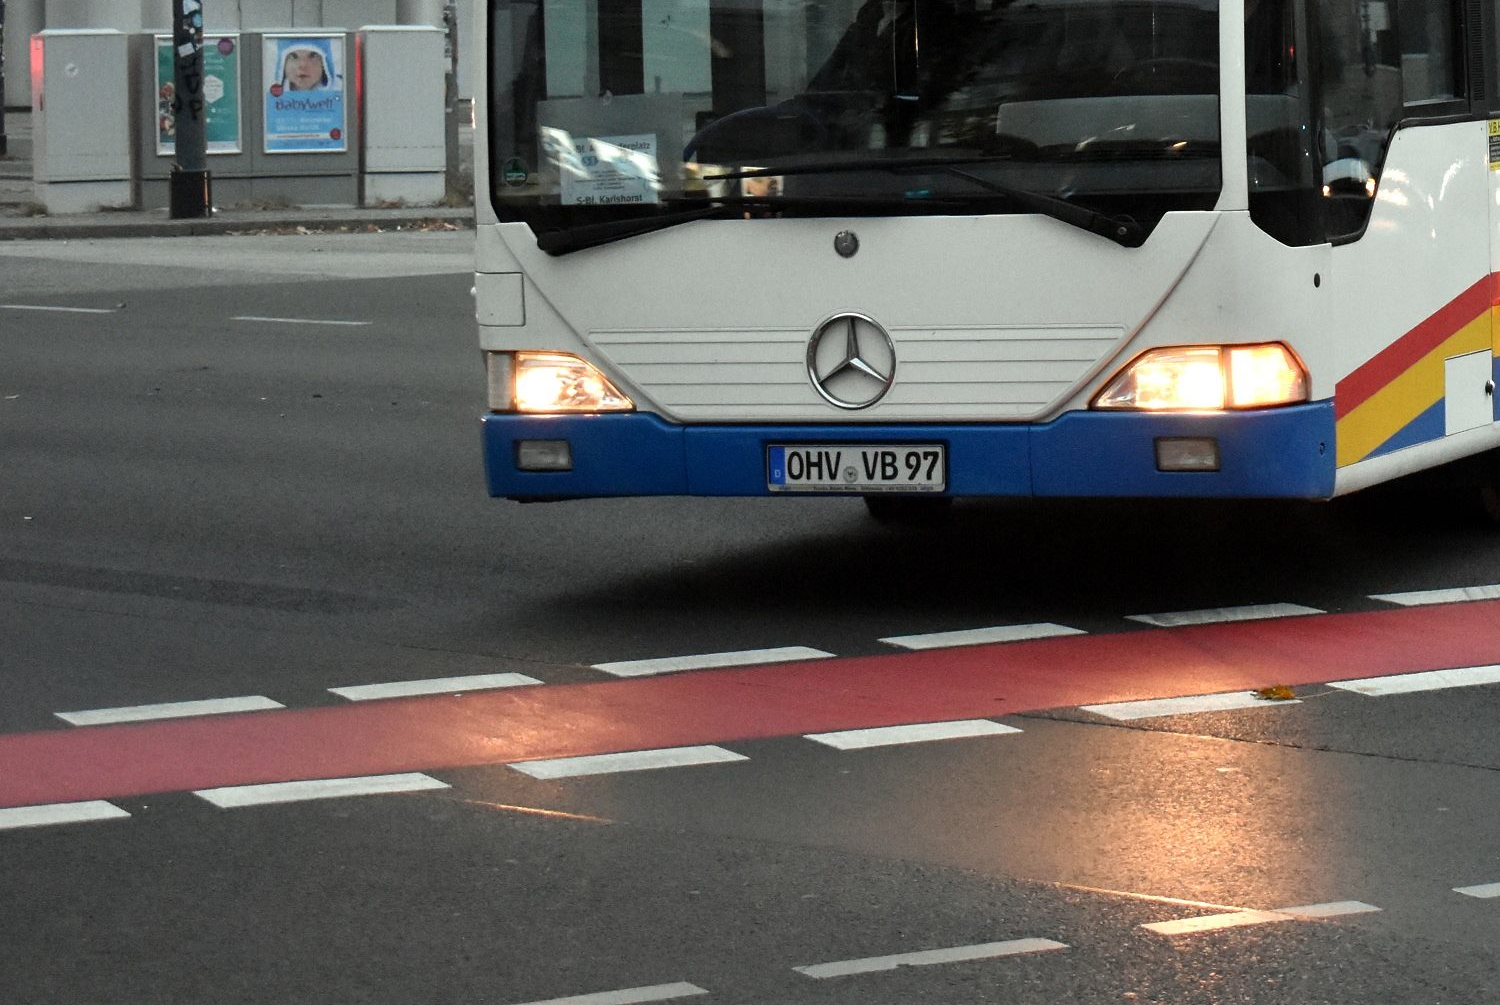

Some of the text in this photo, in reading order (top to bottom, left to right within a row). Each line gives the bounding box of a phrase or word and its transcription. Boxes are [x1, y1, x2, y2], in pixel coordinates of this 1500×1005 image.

[599, 194, 643, 204] Karlshorst
[787, 450, 940, 481] OHV VB 97
